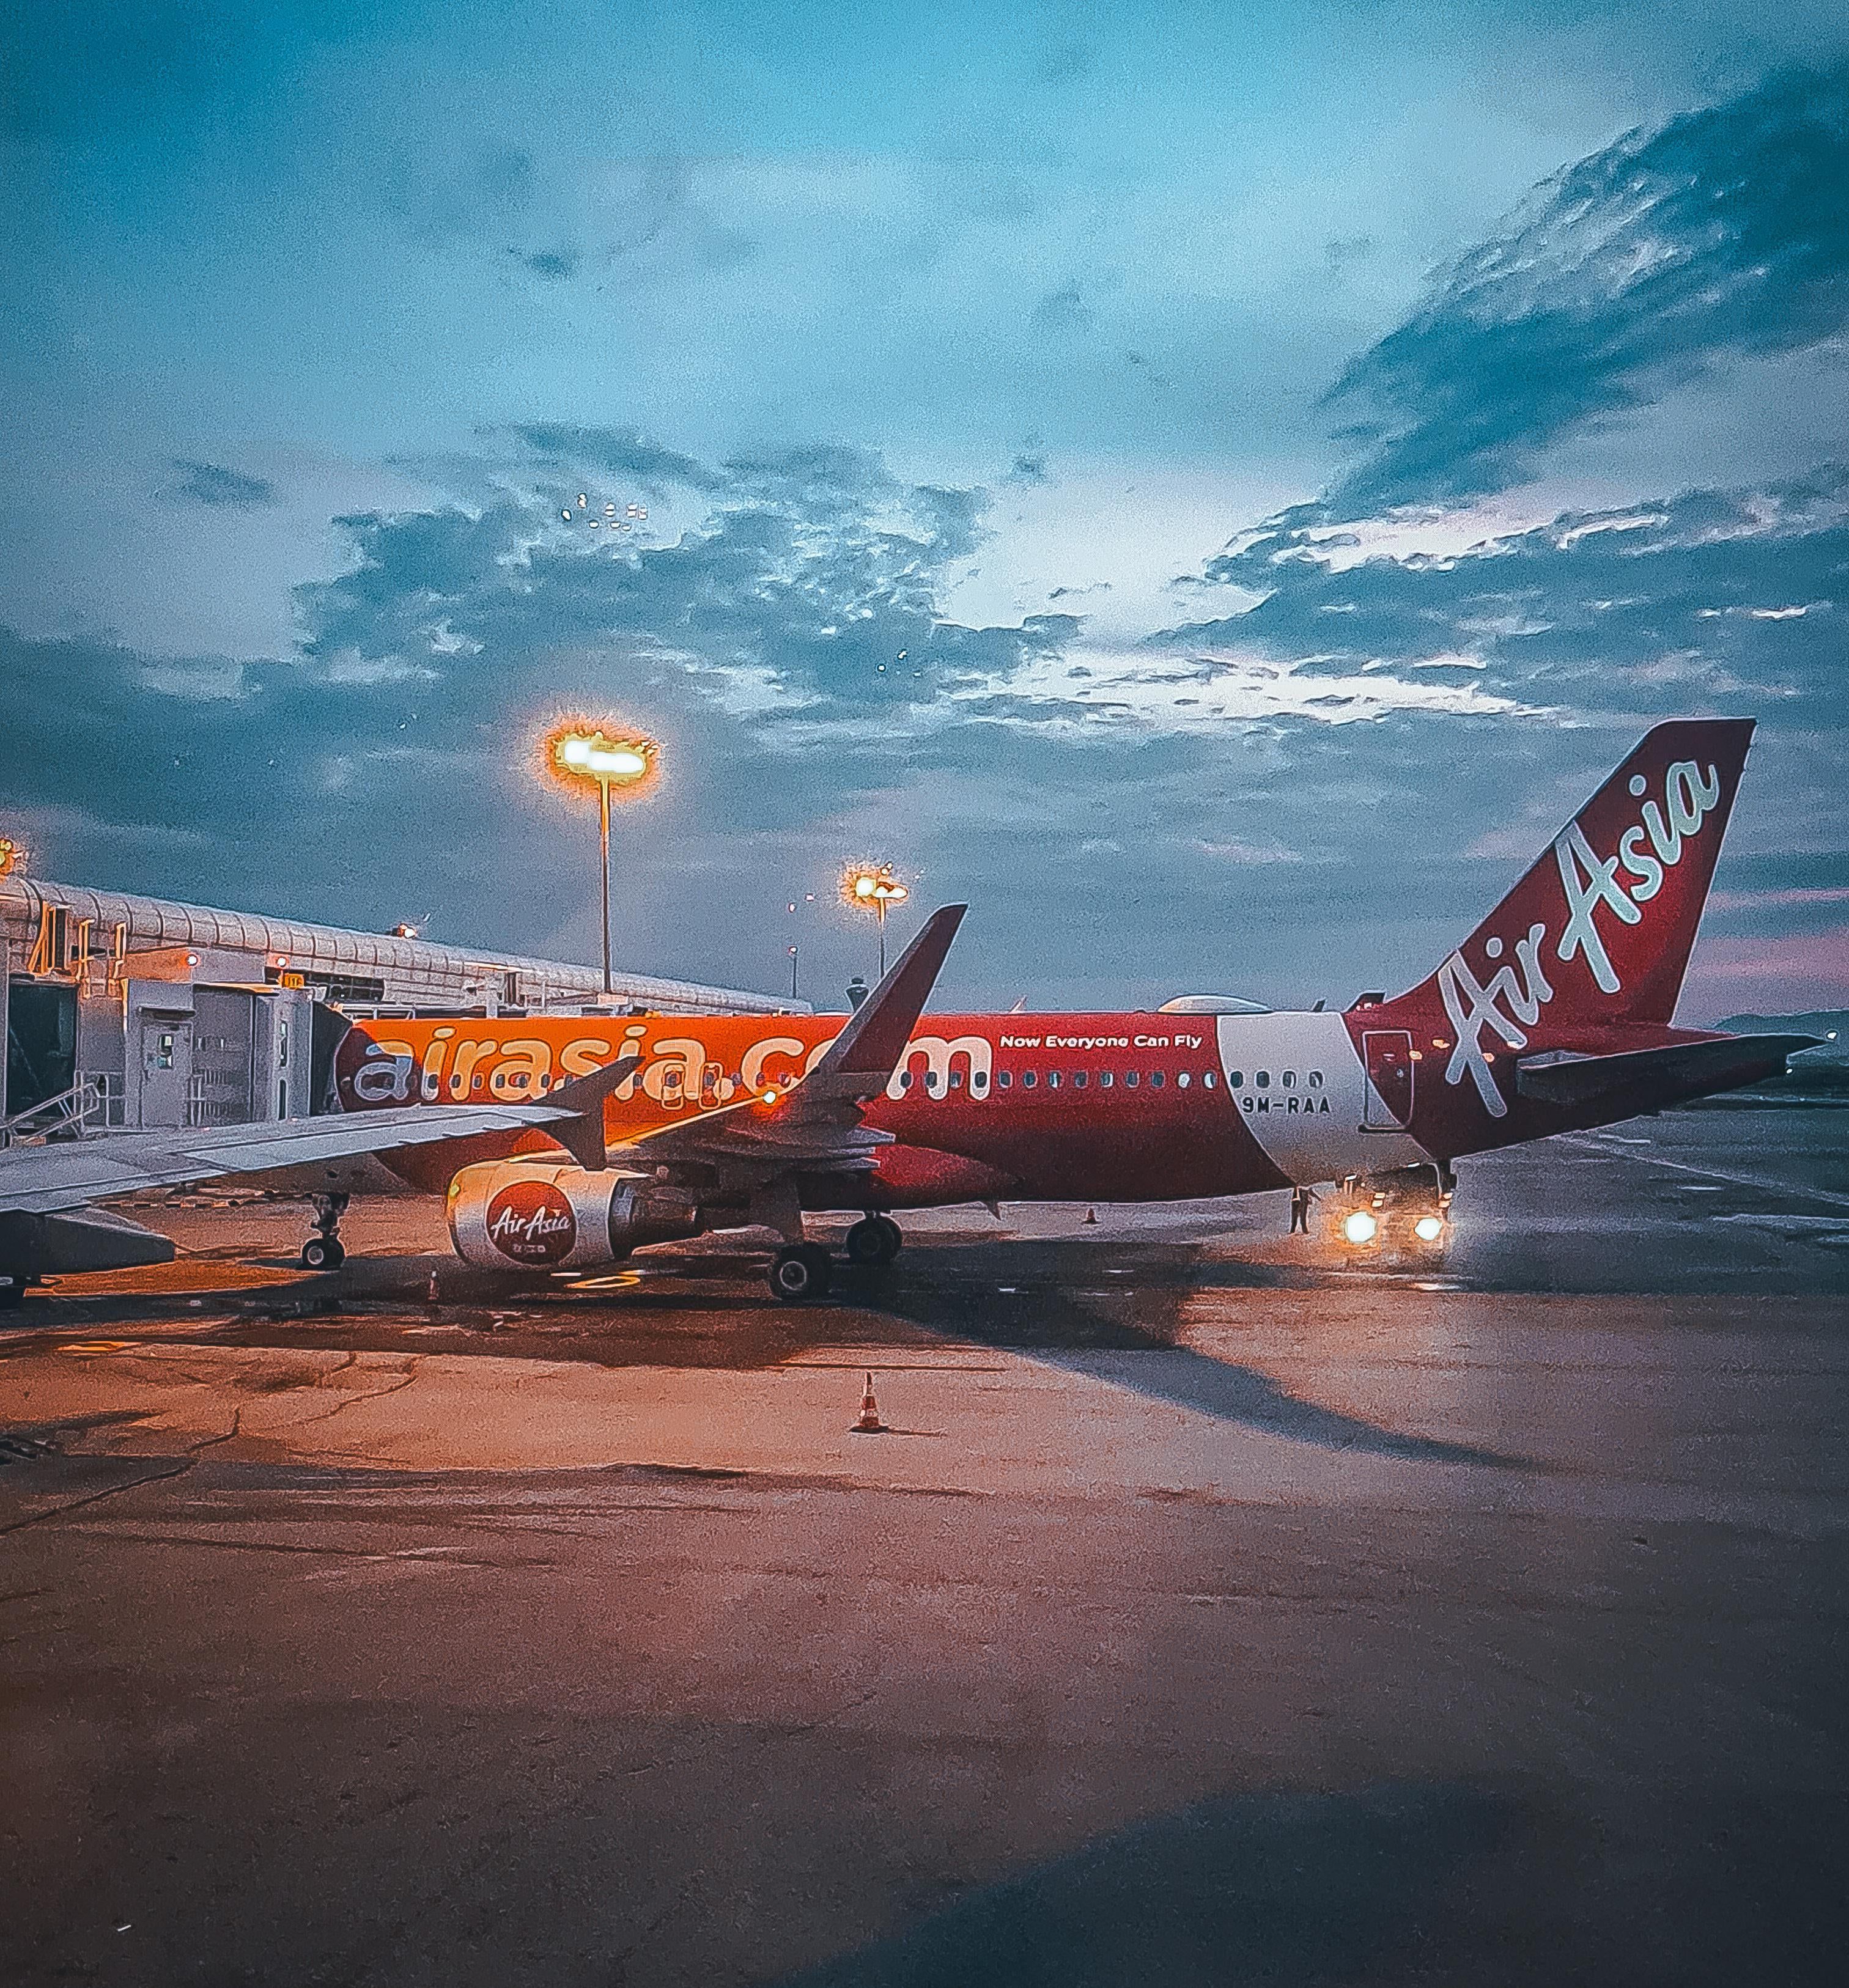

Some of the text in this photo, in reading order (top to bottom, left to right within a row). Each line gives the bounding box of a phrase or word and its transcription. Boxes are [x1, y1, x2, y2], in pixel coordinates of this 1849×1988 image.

[1000, 1034, 1202, 1050] Now Everyone Can Fly
[354, 1026, 992, 1100] airasia.cm
[1242, 1096, 1330, 1114] 9M-RAA
